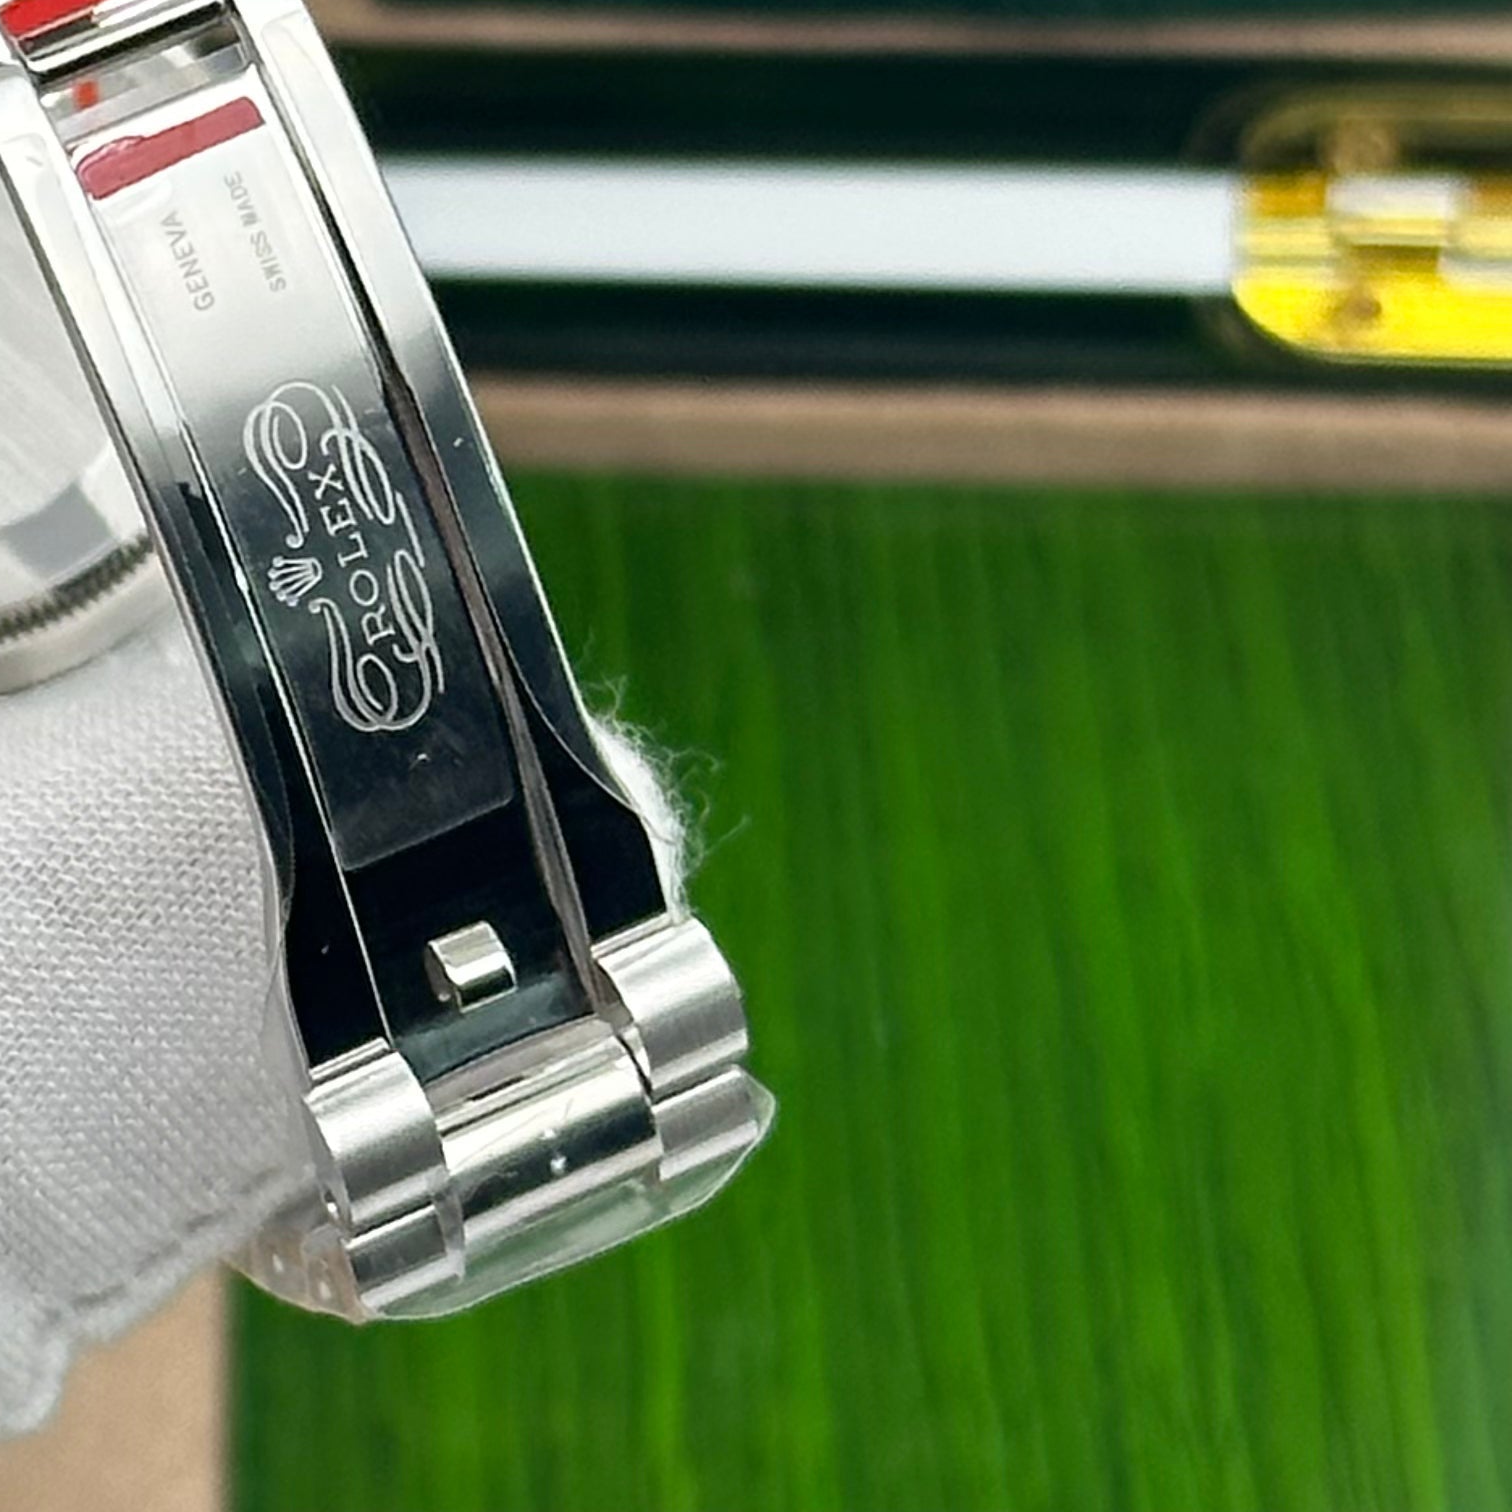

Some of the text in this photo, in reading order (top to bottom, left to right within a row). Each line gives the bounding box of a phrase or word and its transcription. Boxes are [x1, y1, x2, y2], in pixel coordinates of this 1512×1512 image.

[160, 209, 215, 311] GENEVA
[224, 171, 286, 292] SWISS MADE
[308, 464, 395, 645] ROLEX
